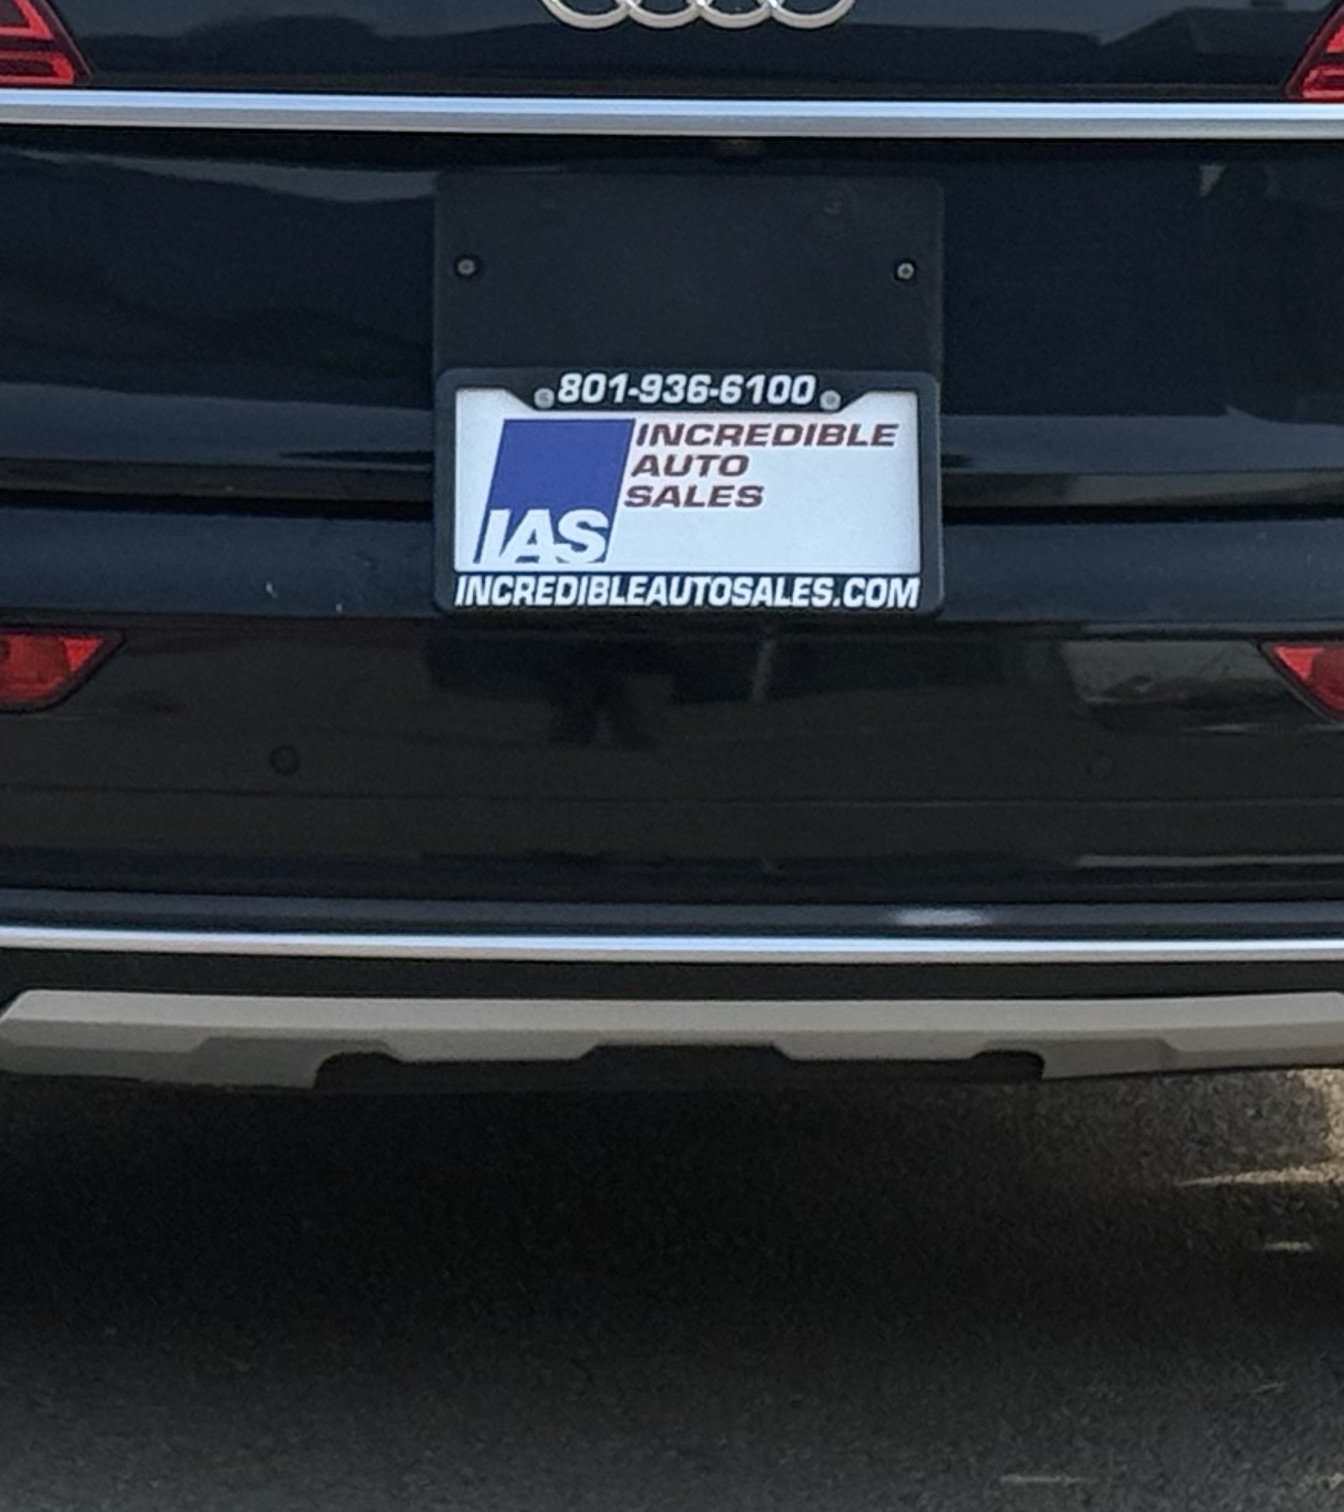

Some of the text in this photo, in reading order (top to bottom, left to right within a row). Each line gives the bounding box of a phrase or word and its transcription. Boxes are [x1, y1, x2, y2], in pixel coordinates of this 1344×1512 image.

[558, 373, 816, 406] 801-936-6100
[635, 423, 899, 447] INCREDIBLE
[631, 454, 749, 477] AUTO
[623, 486, 764, 508] SALES
[478, 508, 610, 564] IAS
[455, 575, 920, 608] INCREDIBLEAUTOSALES.COM
